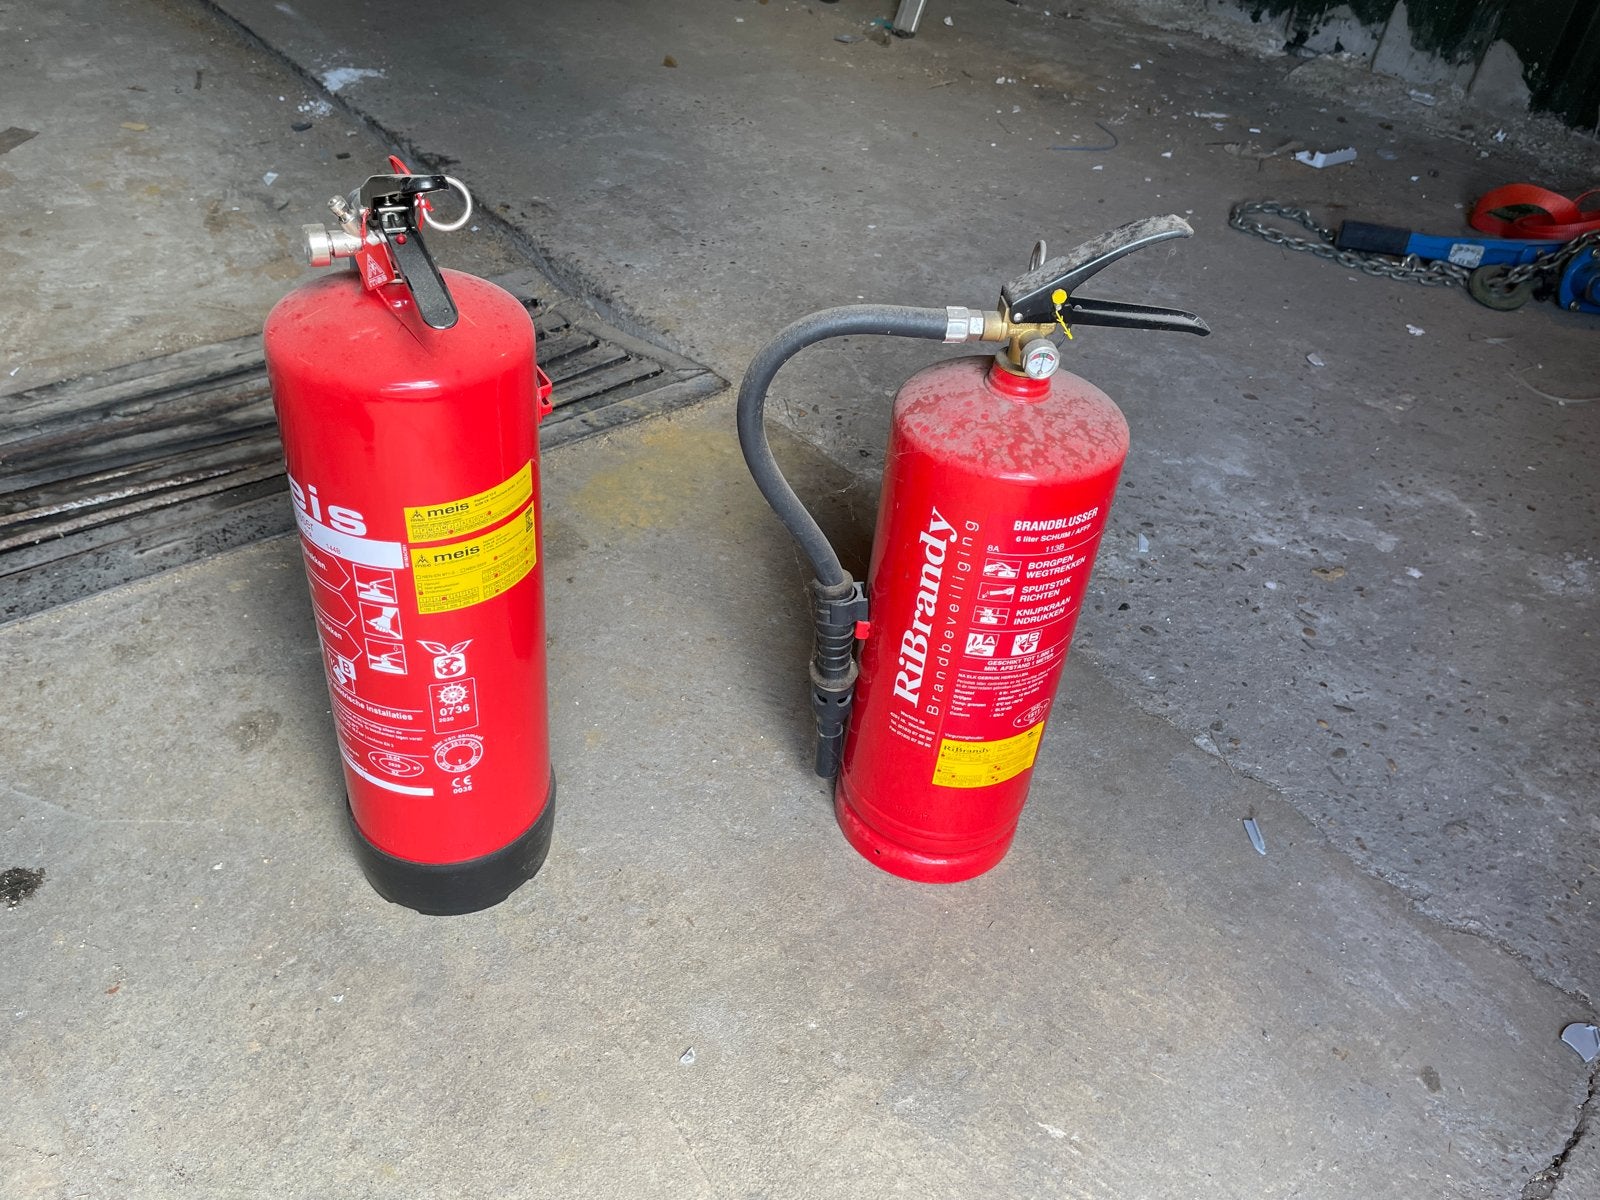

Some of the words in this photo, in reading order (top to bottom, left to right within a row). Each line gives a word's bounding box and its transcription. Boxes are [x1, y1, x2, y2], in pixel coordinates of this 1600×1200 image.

[427, 503, 469, 518] meis
[1014, 507, 1099, 531] BRANDBLUSSER
[1040, 531, 1071, 542] SCHUIM
[1075, 523, 1092, 535] AFFF
[434, 546, 480, 562] meis
[1045, 543, 1065, 553] 113B
[1026, 556, 1086, 579] WEGTREKKEN
[1028, 554, 1074, 570] BORGPEN
[1021, 576, 1072, 594] SPUITSTUK
[1020, 589, 1060, 602] RICHTEN
[893, 506, 957, 708] RiBrandy
[1016, 596, 1071, 616] KNIJPKRAAN
[926, 520, 979, 716] Brandbeveiliging
[1013, 607, 1065, 625] INDRUKKEN
[983, 635, 996, 645] A
[1029, 632, 1040, 642] B
[987, 658, 1022, 666] GESCHIKT
[1000, 662, 1030, 672] AFSTAND
[1036, 653, 1055, 665] METER
[366, 704, 413, 721] installaties
[440, 704, 470, 716] 0736
